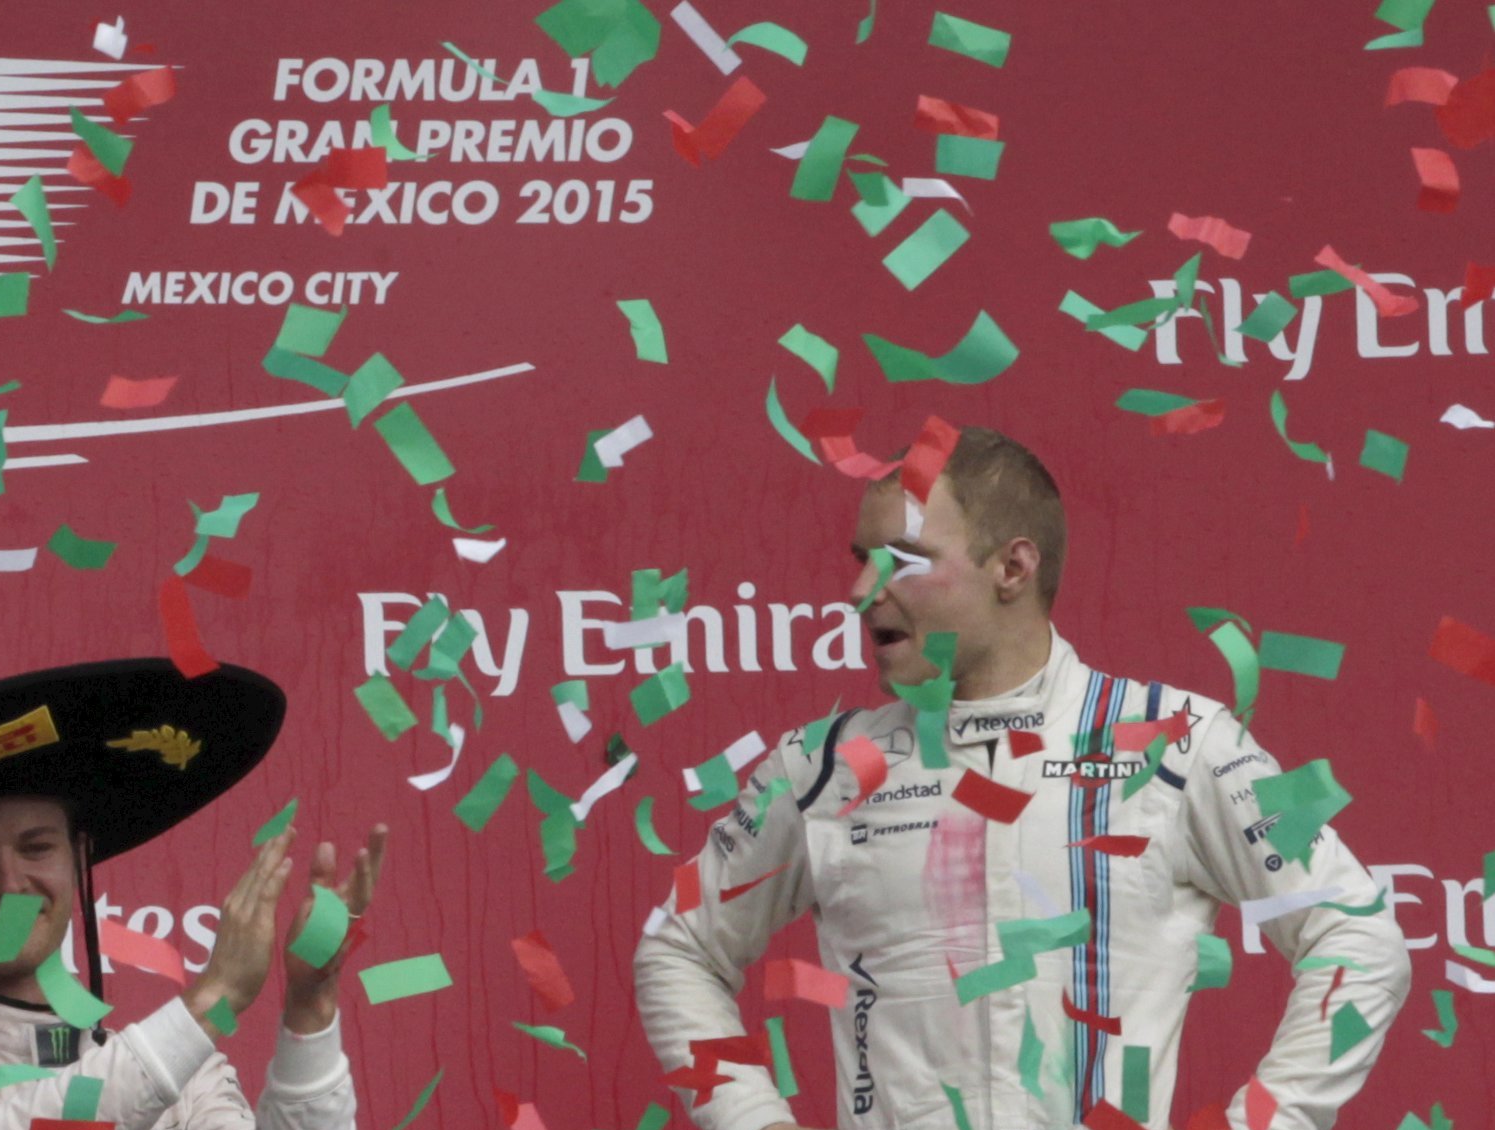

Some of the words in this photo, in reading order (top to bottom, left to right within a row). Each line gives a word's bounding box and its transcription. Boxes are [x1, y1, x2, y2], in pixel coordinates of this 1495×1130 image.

[273, 57, 542, 101] FORMULA
[568, 57, 591, 98] 1
[415, 118, 633, 163] PREMIO
[190, 181, 259, 225] DE
[516, 179, 654, 225] 2015
[121, 271, 294, 305] MEXICO
[304, 271, 399, 305] CITY
[356, 591, 530, 697] Fy
[975, 712, 1045, 733] Rexona
[1044, 761, 1142, 778] MARTINI
[872, 820, 938, 837] PETROBRAS
[853, 988, 878, 1115] Rexona
